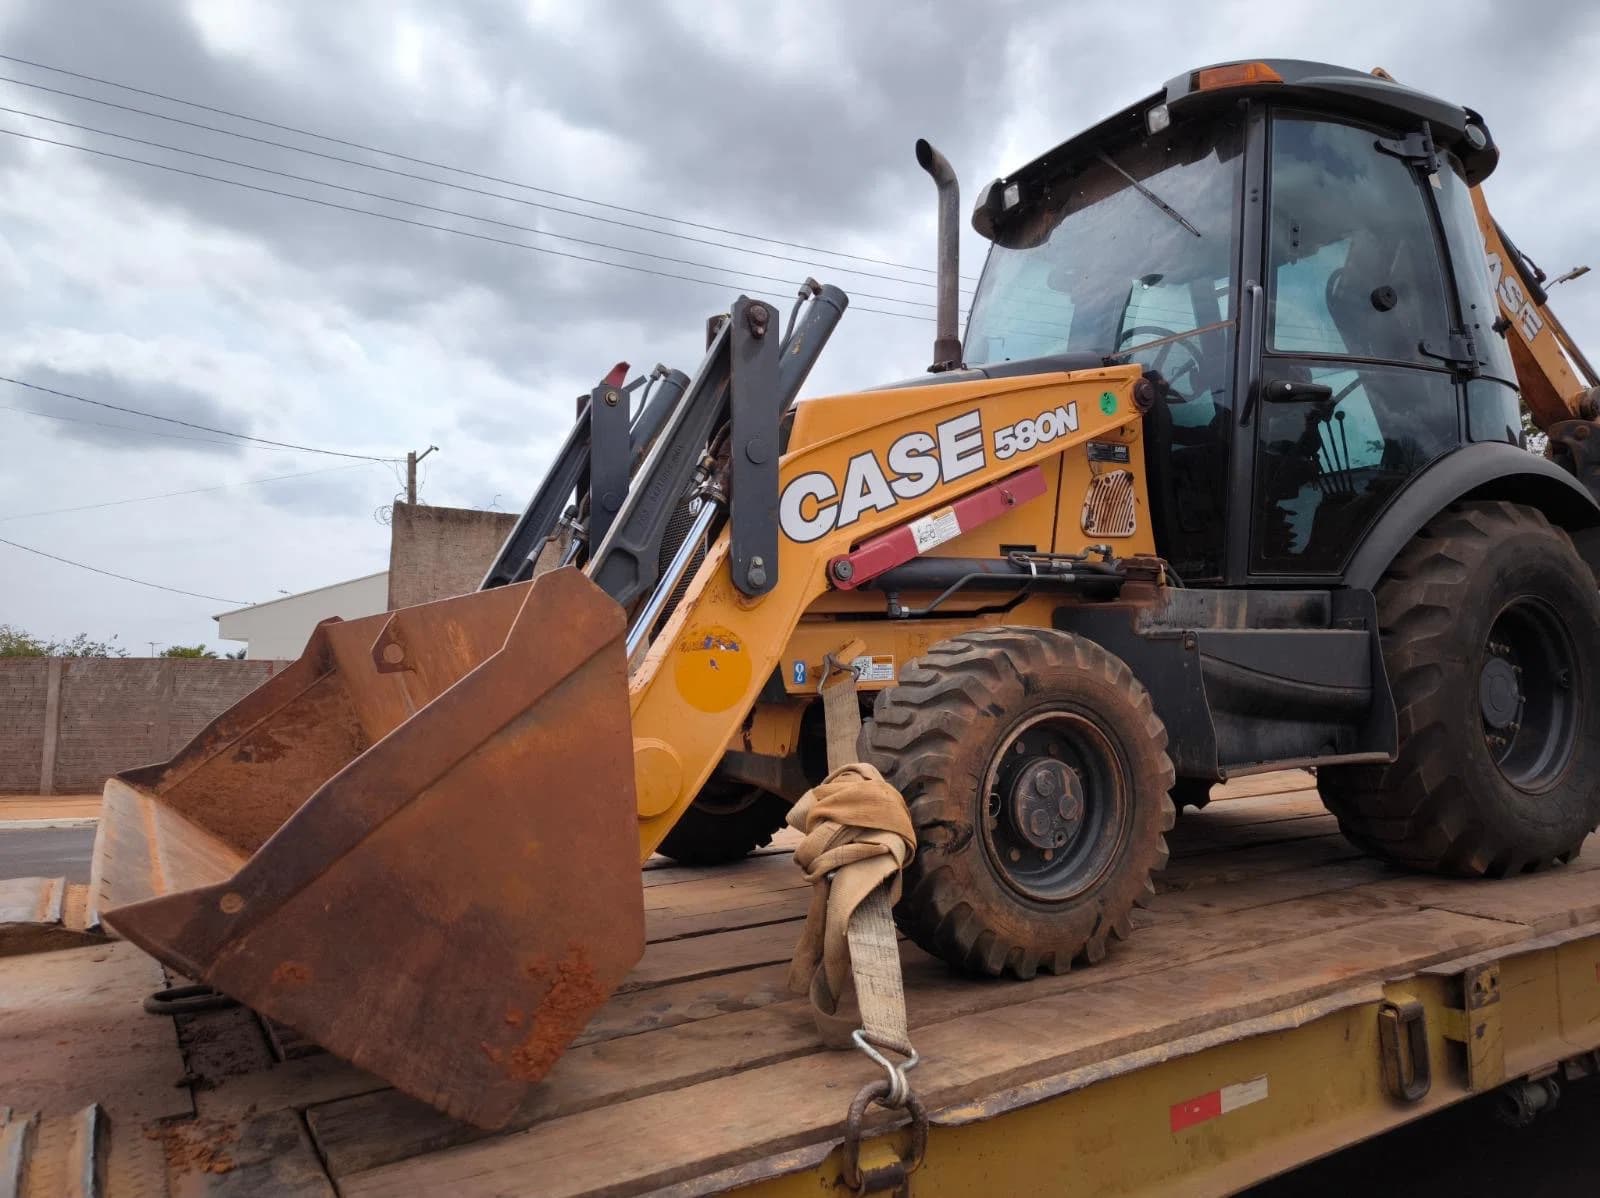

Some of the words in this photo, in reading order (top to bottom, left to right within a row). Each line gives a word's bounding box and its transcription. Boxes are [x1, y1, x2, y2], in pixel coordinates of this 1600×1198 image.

[1482, 234, 1543, 342] ASE
[779, 409, 986, 543] CASE
[993, 401, 1079, 460] 580N
